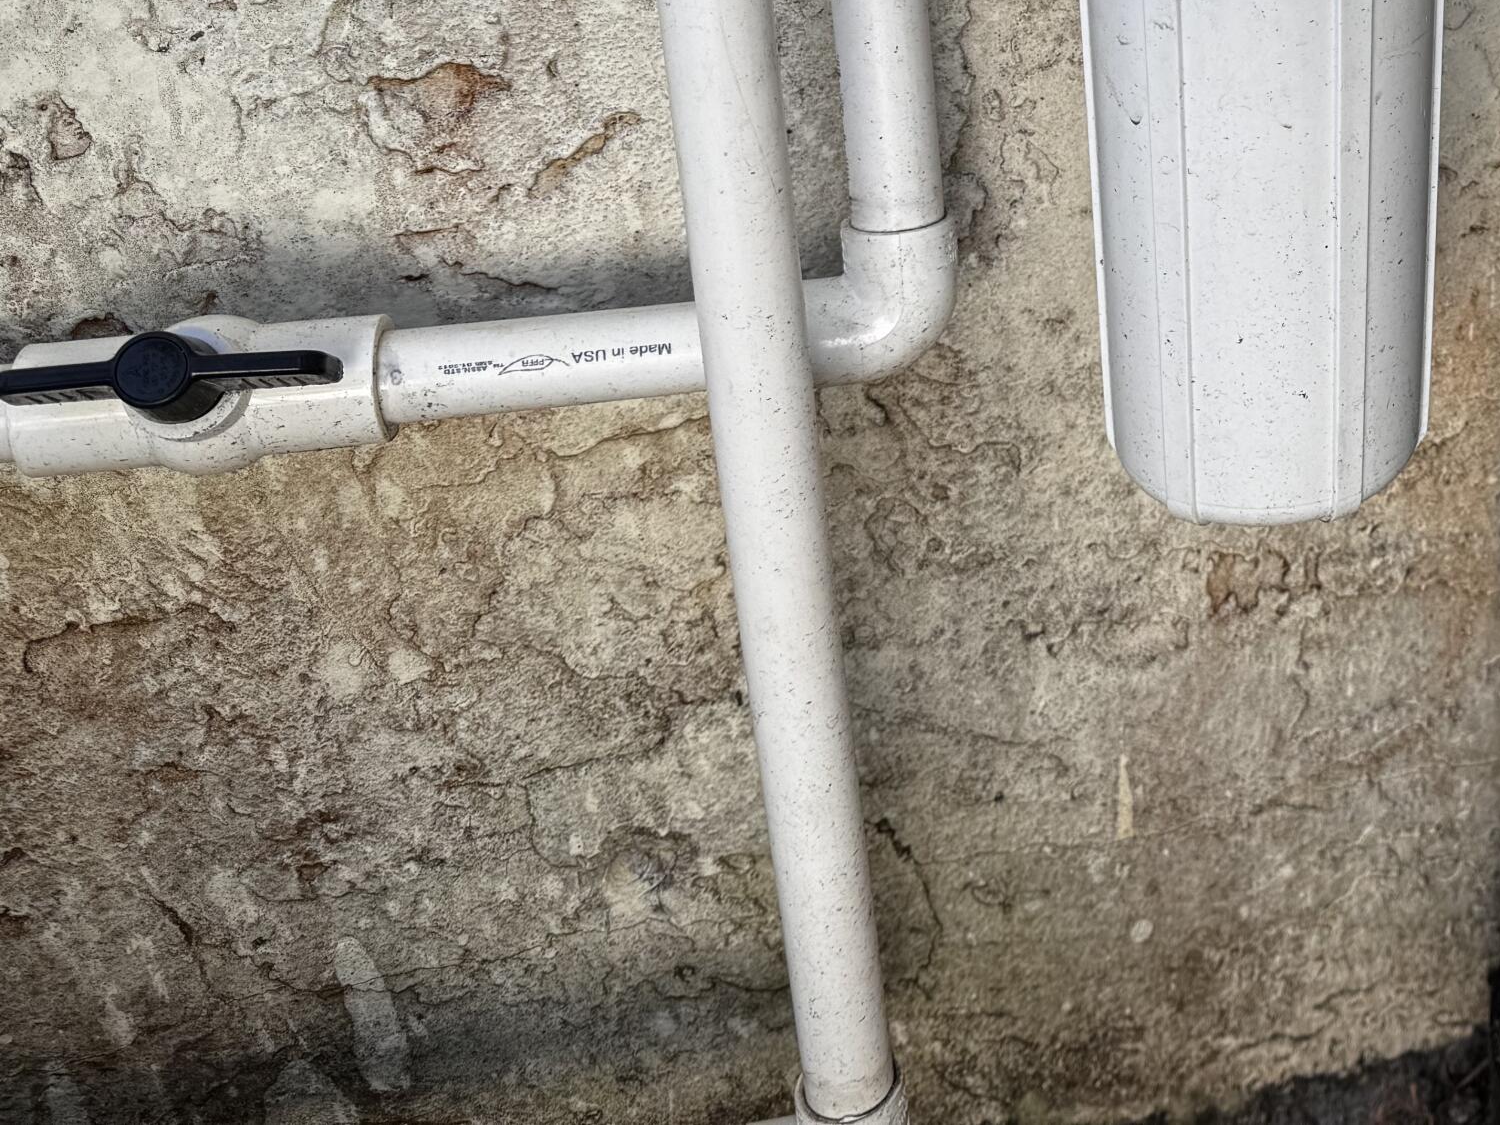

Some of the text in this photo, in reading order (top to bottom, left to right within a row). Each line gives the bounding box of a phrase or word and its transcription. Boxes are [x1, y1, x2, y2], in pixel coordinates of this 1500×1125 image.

[571, 342, 672, 364] Made in USA
